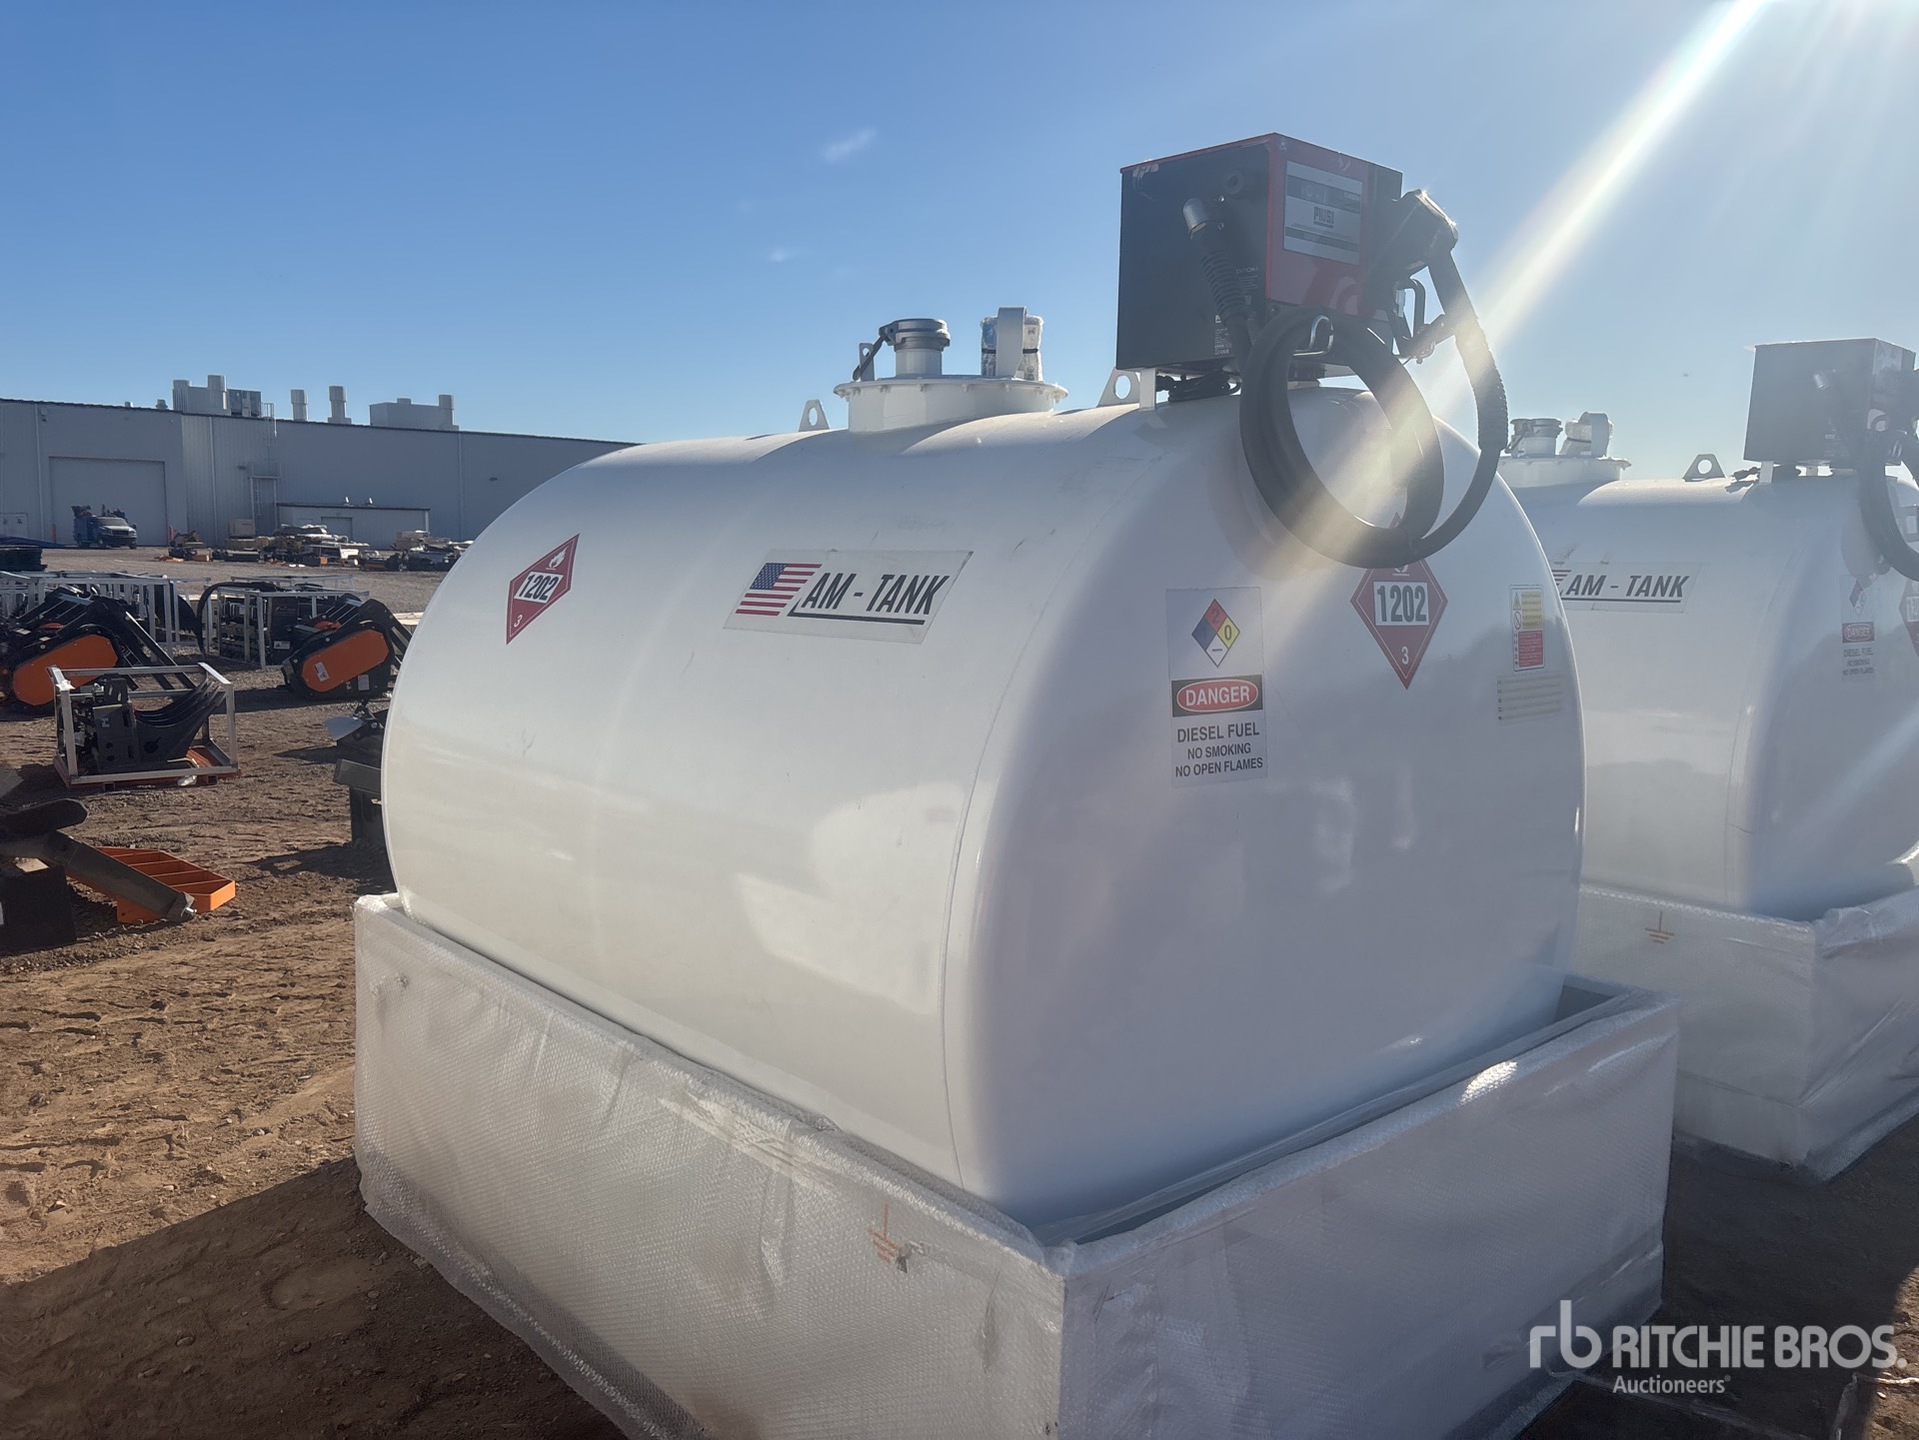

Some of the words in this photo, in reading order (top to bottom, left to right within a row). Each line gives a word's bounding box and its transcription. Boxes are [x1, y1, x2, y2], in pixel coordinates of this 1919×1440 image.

[518, 574, 560, 601] 1202
[801, 572, 857, 610] AM
[866, 574, 950, 615] TANK
[1565, 574, 1607, 596] AM
[1625, 575, 1690, 598] TANK
[1376, 584, 1427, 623] 1202
[513, 614, 523, 628] 3
[1211, 608, 1220, 624] 2
[1224, 624, 1232, 641] 0
[1401, 646, 1409, 665] 3
[1185, 685, 1250, 706] DANGER
[1177, 725, 1224, 743] DIESEL
[1228, 722, 1260, 738] FUEL
[1187, 747, 1203, 760] NO
[1205, 742, 1251, 758] SMOKING
[1175, 765, 1191, 778] NO
[1193, 761, 1222, 775] OPEN
[1224, 757, 1263, 773] FLAMES
